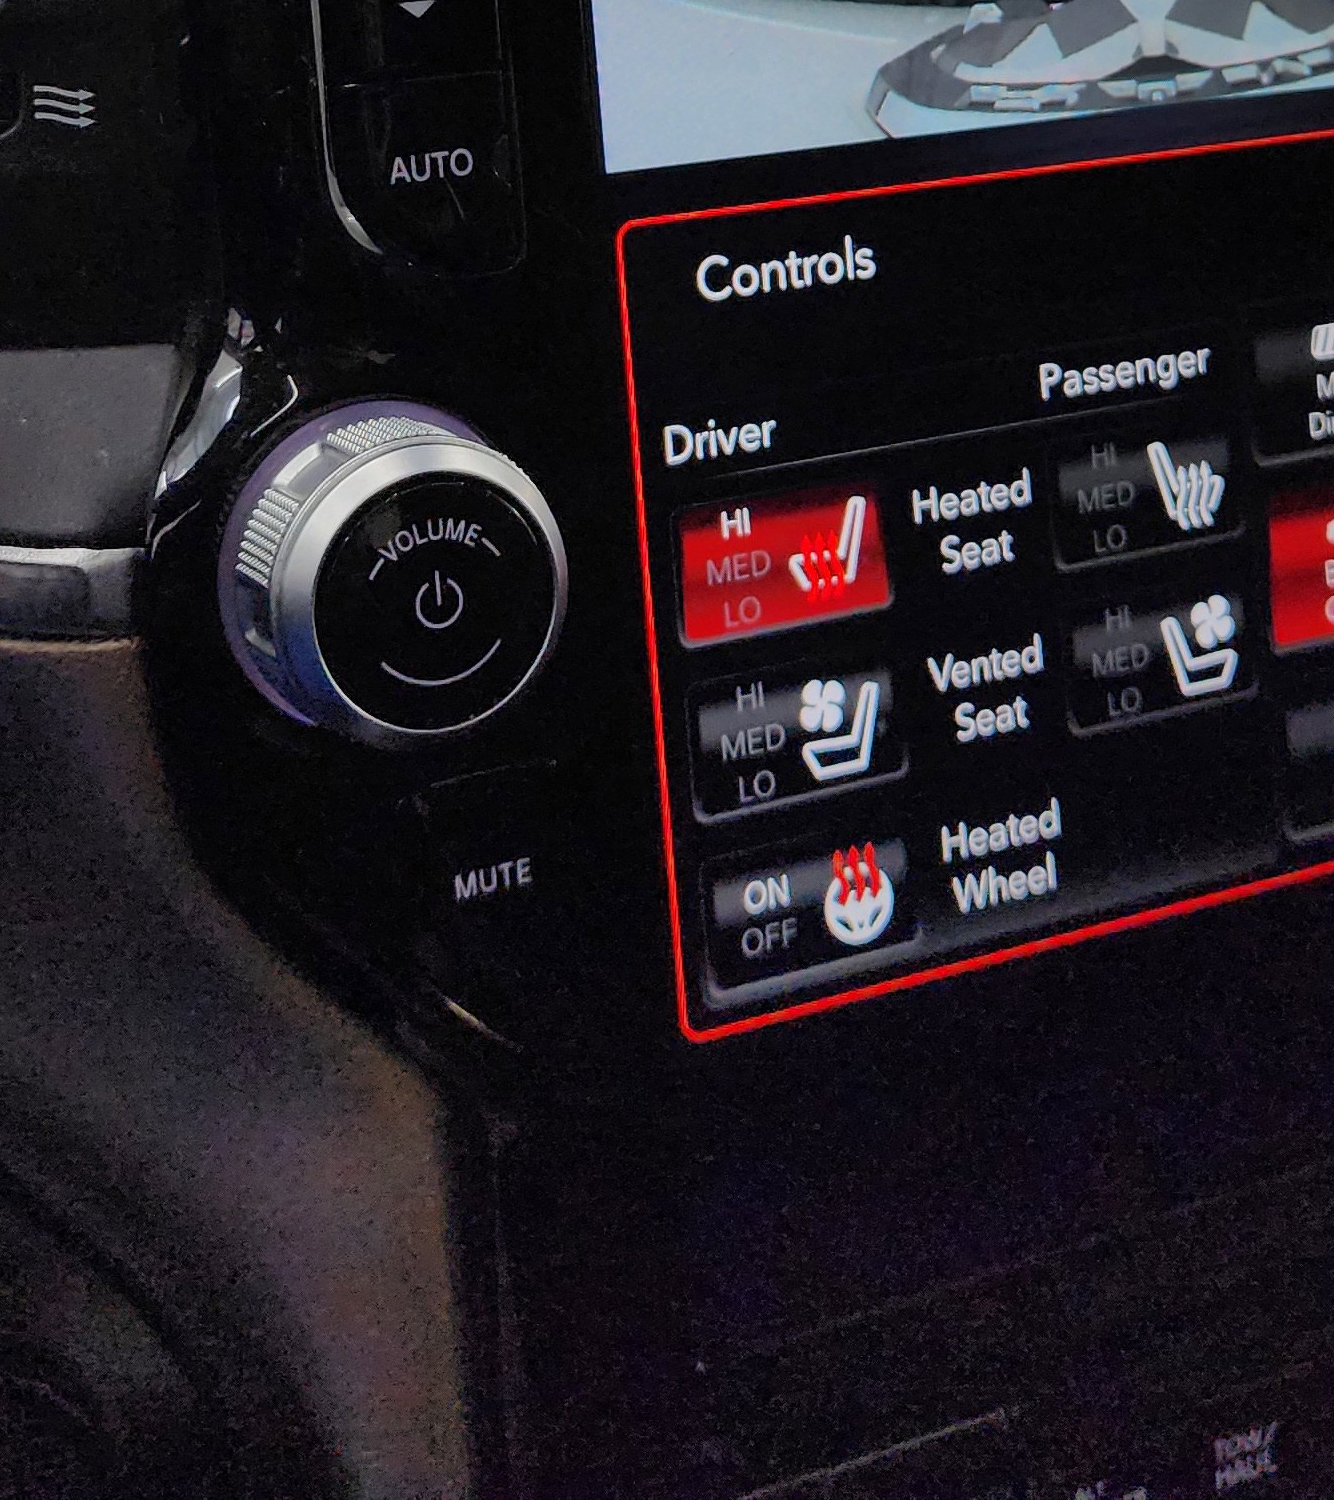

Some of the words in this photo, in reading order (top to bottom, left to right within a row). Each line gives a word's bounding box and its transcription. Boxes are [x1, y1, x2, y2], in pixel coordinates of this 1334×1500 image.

[389, 146, 474, 185] AUTO
[696, 234, 877, 303] Controls
[1037, 343, 1212, 404] Passenger
[663, 414, 775, 467] Driver
[1091, 442, 1116, 470] HI
[911, 467, 1032, 525] Heated
[1077, 480, 1136, 514] MED
[378, 518, 483, 564] VOLUME
[721, 507, 751, 540] HI
[1093, 524, 1128, 552] LO
[706, 549, 771, 586] MED
[939, 530, 1015, 575] Seat
[723, 595, 762, 629] LO
[1105, 604, 1131, 632] HI
[927, 632, 1044, 693] Vented
[1092, 643, 1151, 677] MED
[735, 681, 765, 712] HI
[1107, 686, 1143, 716] LO
[954, 696, 1029, 742] Seat
[721, 723, 786, 762] MED
[739, 769, 777, 804] LO
[941, 796, 1062, 864] Heated
[453, 857, 533, 902] MUTE
[744, 873, 792, 915] ON
[952, 850, 1057, 914] Wheel
[741, 917, 797, 958] OFF
